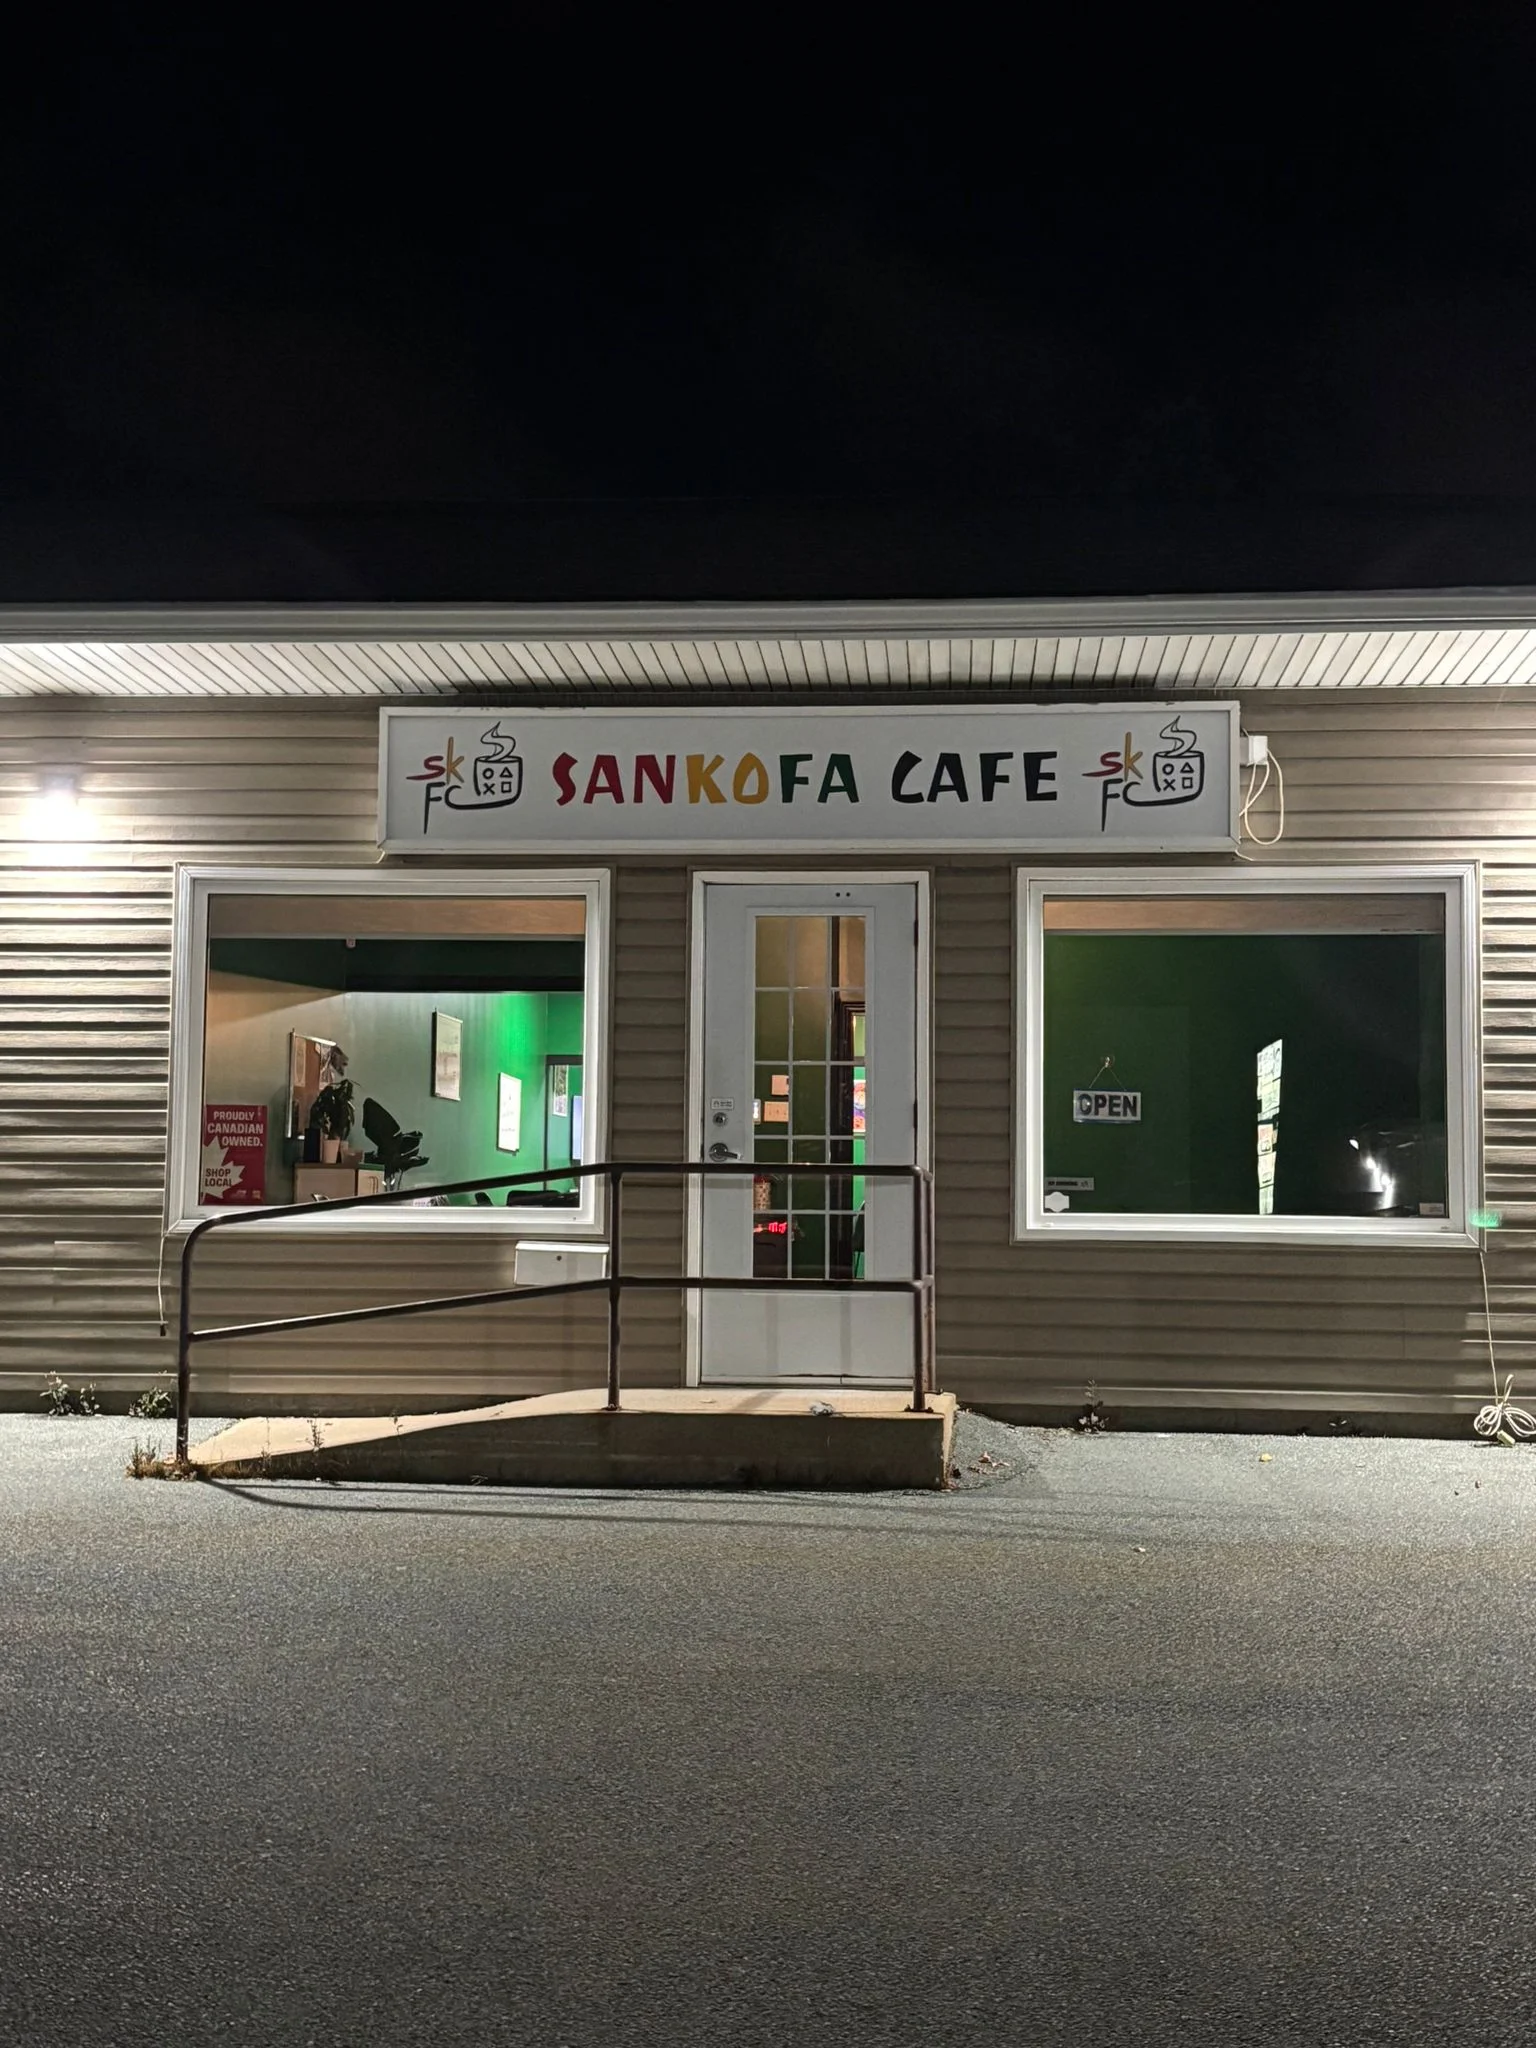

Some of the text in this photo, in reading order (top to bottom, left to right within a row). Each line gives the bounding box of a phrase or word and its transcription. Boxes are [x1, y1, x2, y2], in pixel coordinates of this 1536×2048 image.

[552, 750, 1058, 806] SANKOFA CAFE
[1078, 1093, 1138, 1117] OPEN
[213, 1111, 255, 1121] PROUDLY
[207, 1123, 264, 1134] CANADIAN
[222, 1136, 263, 1147] OWNED.
[205, 1168, 231, 1177] SHOP
[205, 1178, 232, 1187] LOCAL
